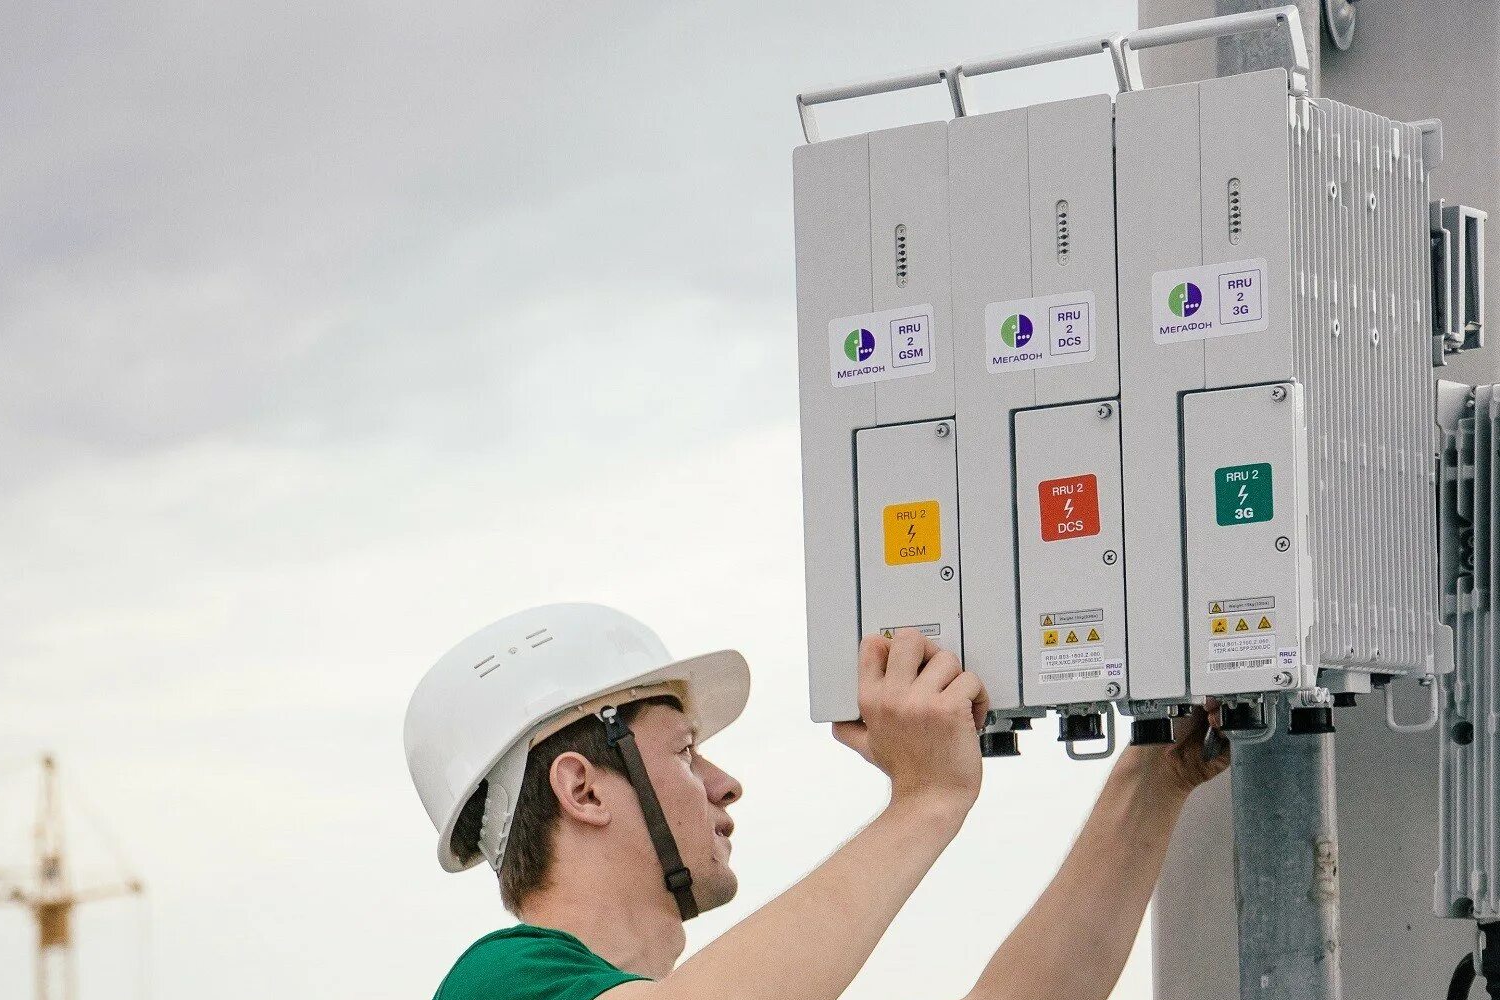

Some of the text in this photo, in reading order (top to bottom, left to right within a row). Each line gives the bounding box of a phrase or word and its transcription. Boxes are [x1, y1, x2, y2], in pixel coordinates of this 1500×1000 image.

[1227, 278, 1253, 291] RRU
[1237, 292, 1244, 302] 2
[1057, 310, 1082, 323] RRU
[1233, 304, 1249, 316] 3G
[898, 322, 921, 335] RRU
[1066, 324, 1073, 335] 2
[907, 337, 915, 347] 2
[1058, 335, 1082, 348] DCS
[899, 348, 925, 361] GSM
[1226, 470, 1258, 482] RRU 2
[1052, 483, 1083, 496] RRU 2
[896, 508, 926, 521] RRU 2
[1235, 507, 1254, 519] 3G
[1057, 520, 1084, 534] DCS
[899, 546, 927, 559] GSM
